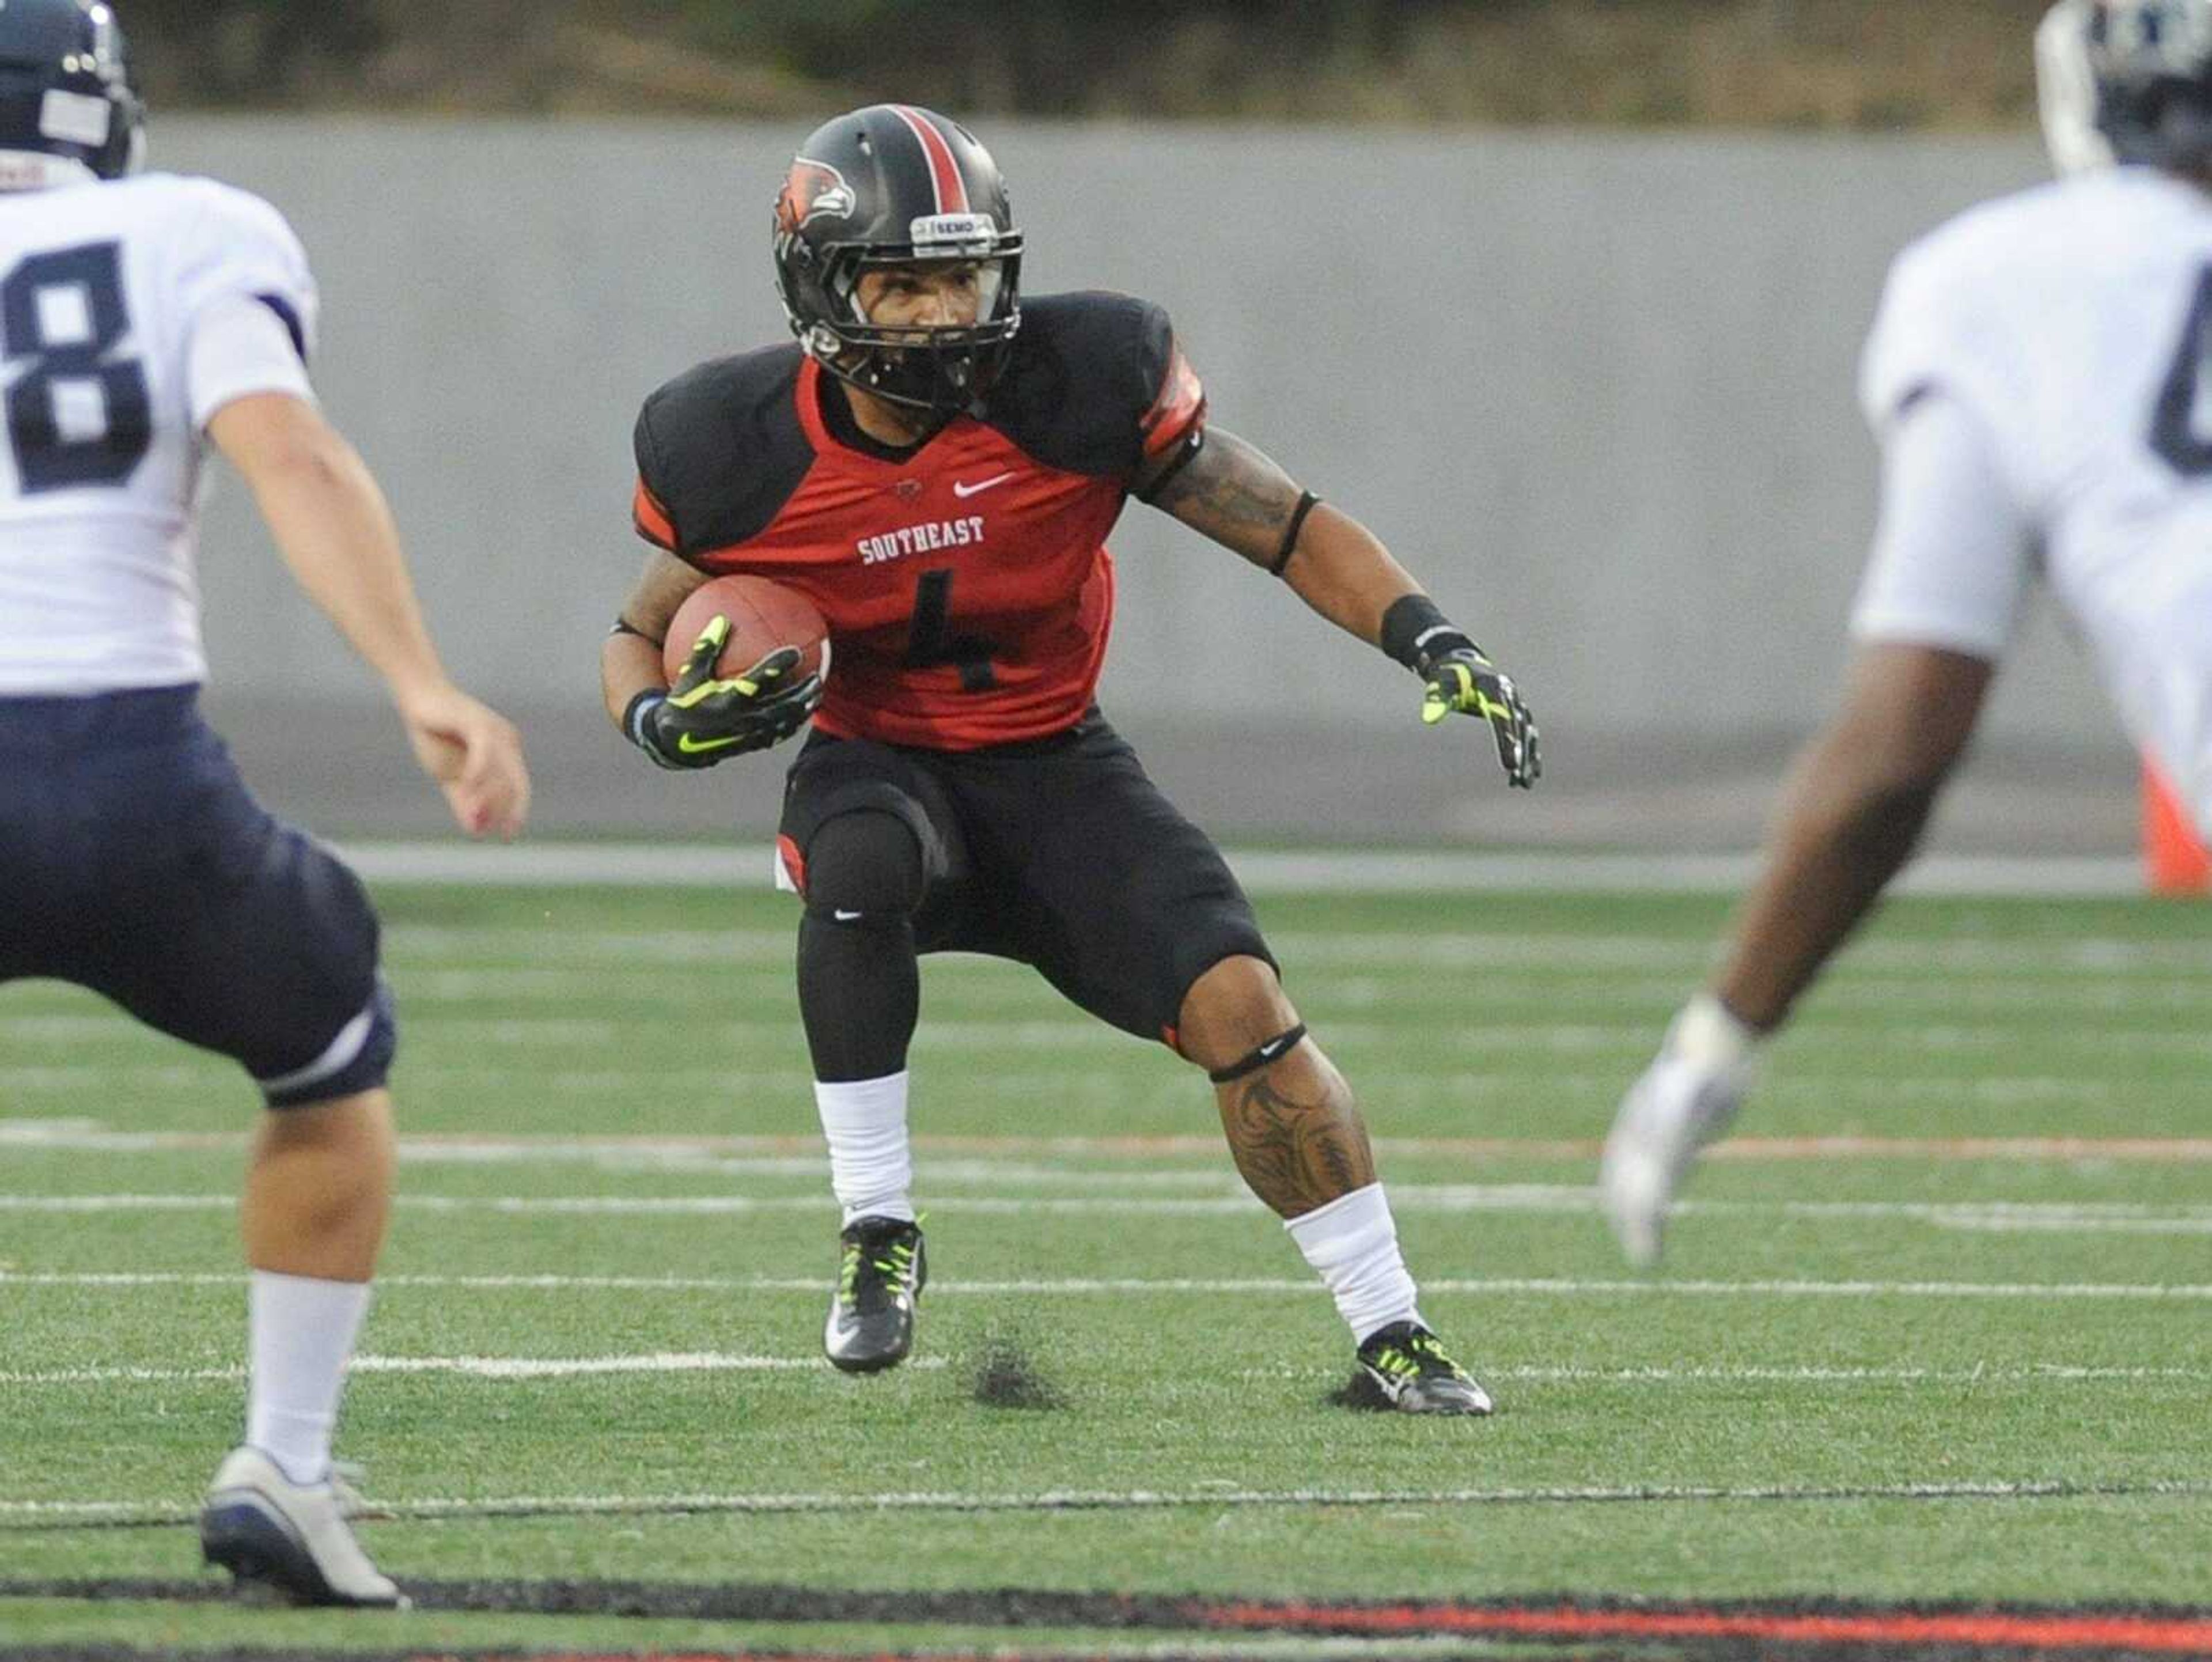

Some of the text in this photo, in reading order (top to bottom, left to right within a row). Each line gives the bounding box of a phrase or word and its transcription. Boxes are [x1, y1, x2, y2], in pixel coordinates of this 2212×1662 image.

[937, 221, 974, 233] SEMO
[0, 241, 152, 495] 8
[857, 516, 984, 565] SOUTHEAST
[908, 567, 999, 694] 4
